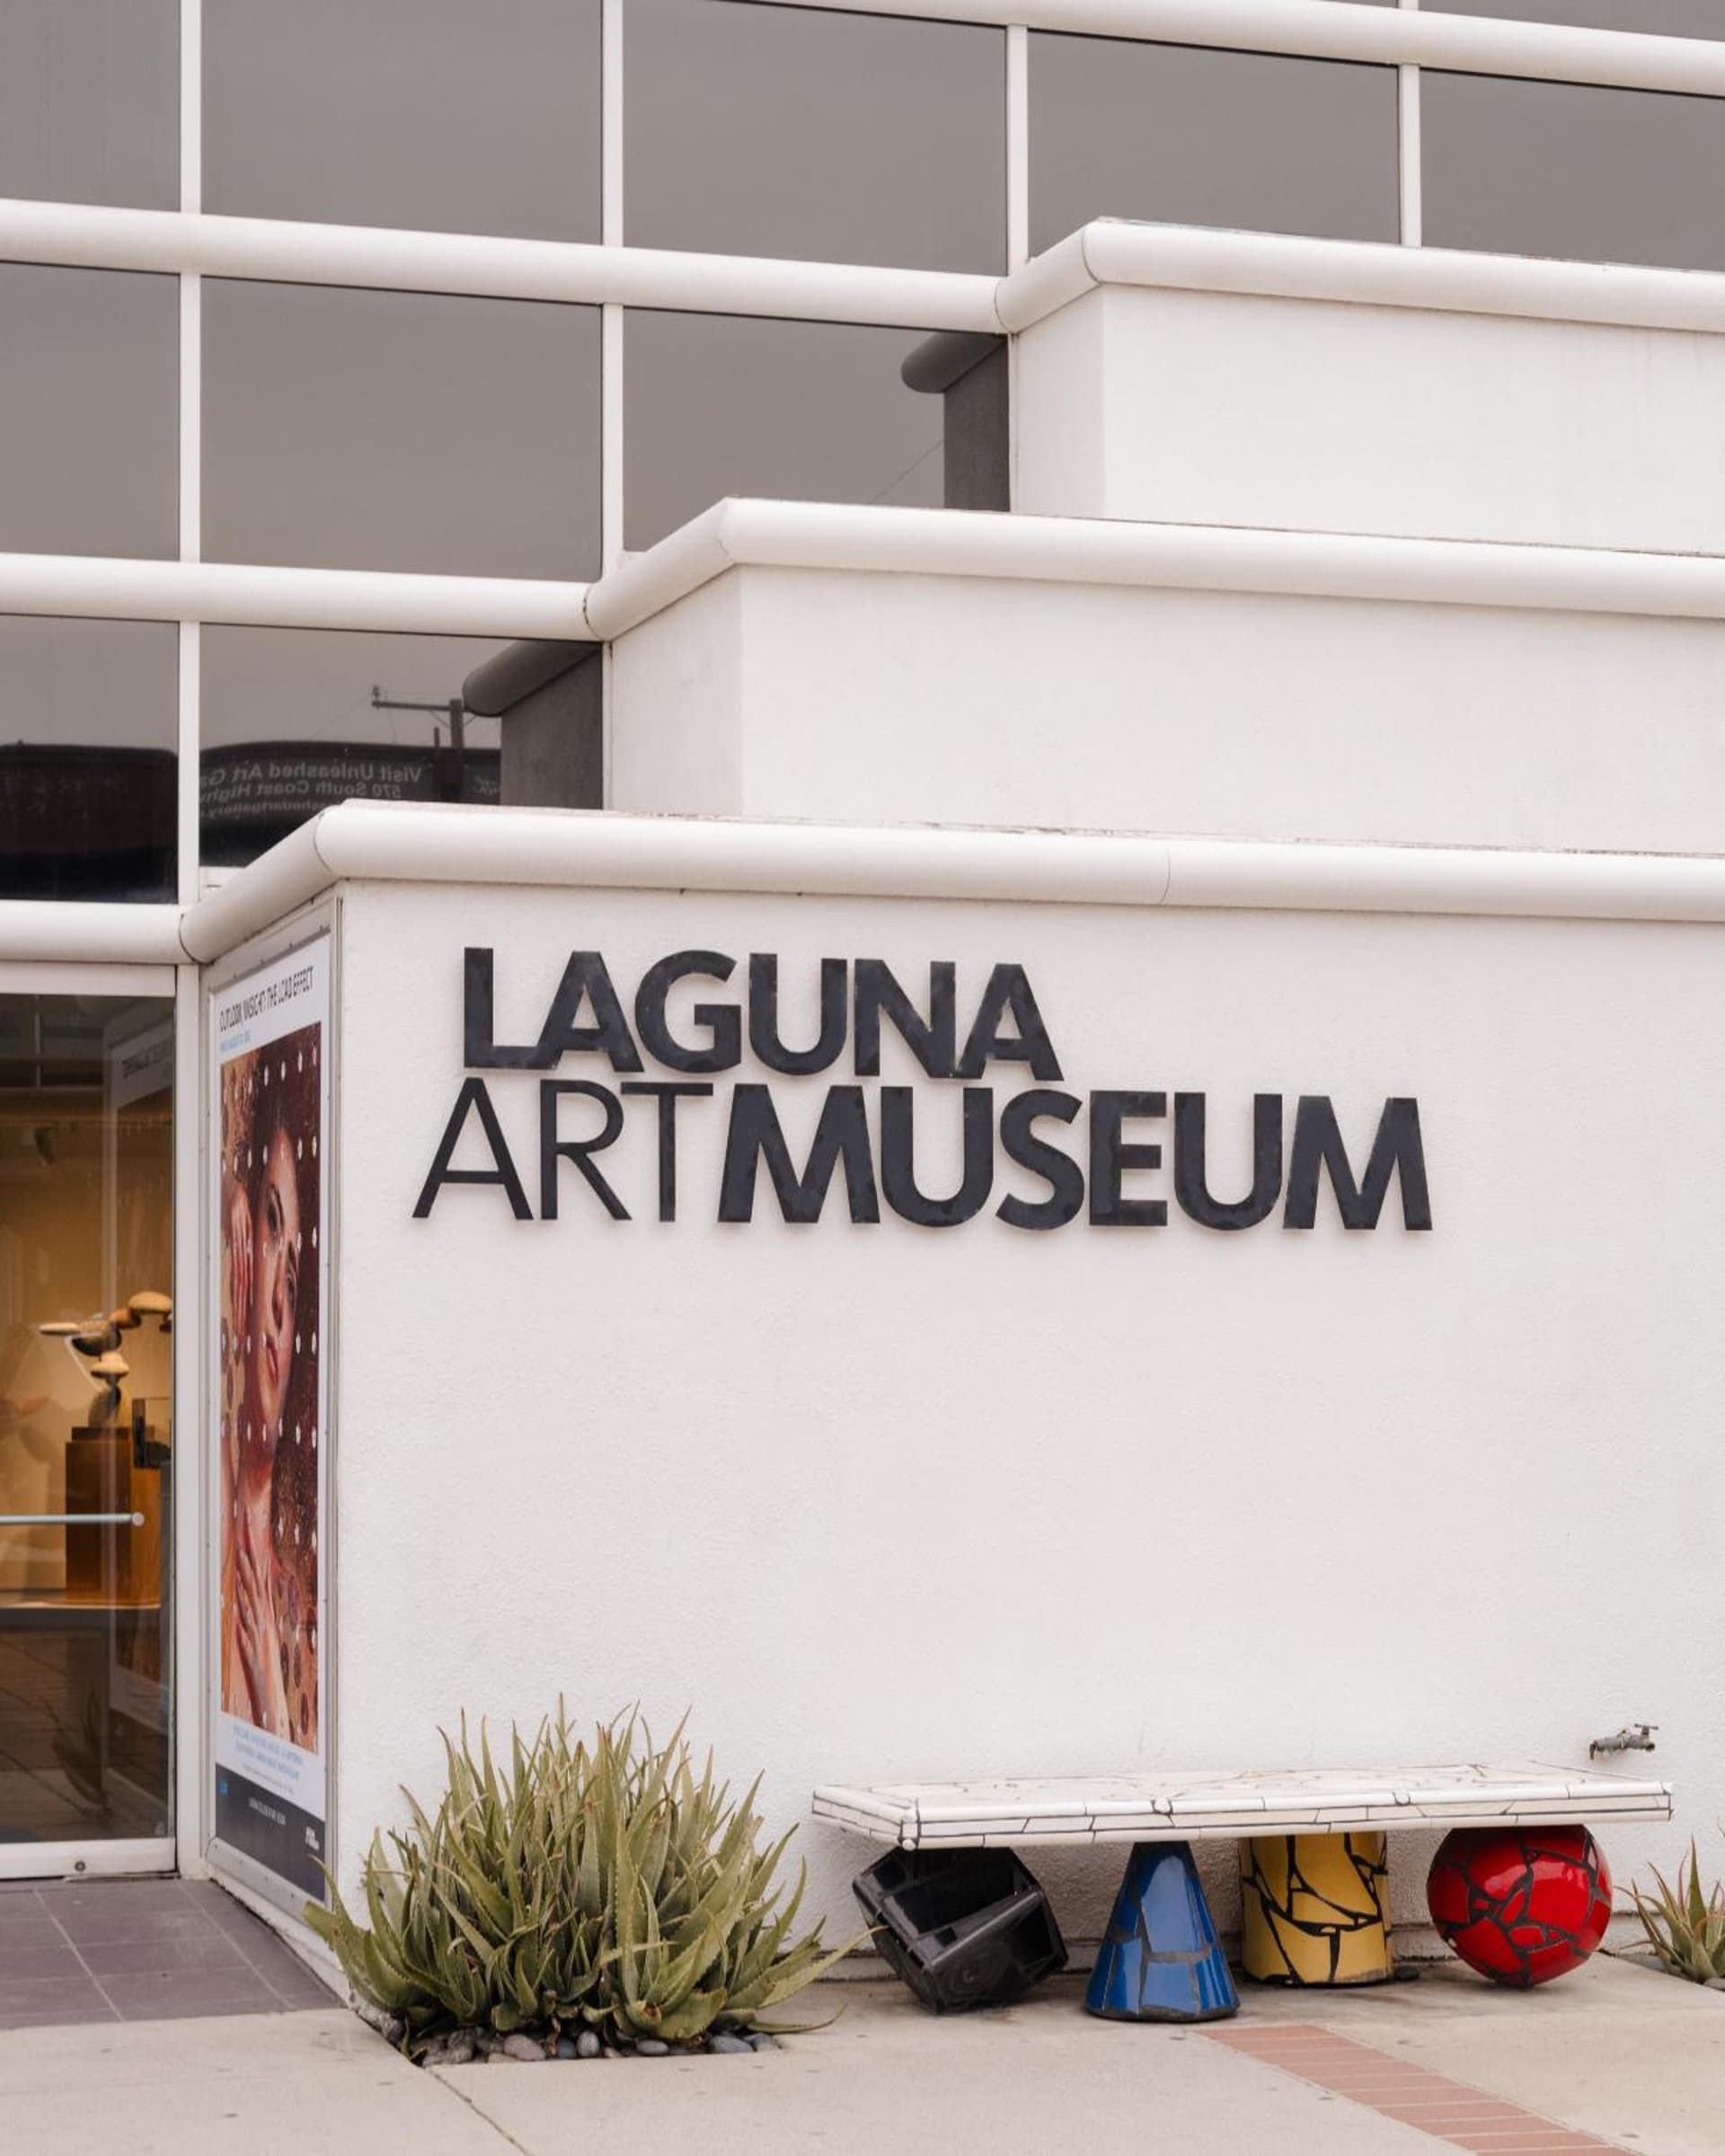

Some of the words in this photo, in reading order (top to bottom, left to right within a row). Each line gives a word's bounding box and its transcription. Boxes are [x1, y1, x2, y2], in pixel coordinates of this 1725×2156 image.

[463, 946, 1064, 1082] LAGUNA
[411, 1077, 713, 1222] ART
[717, 1083, 1431, 1231] MUSEUM
